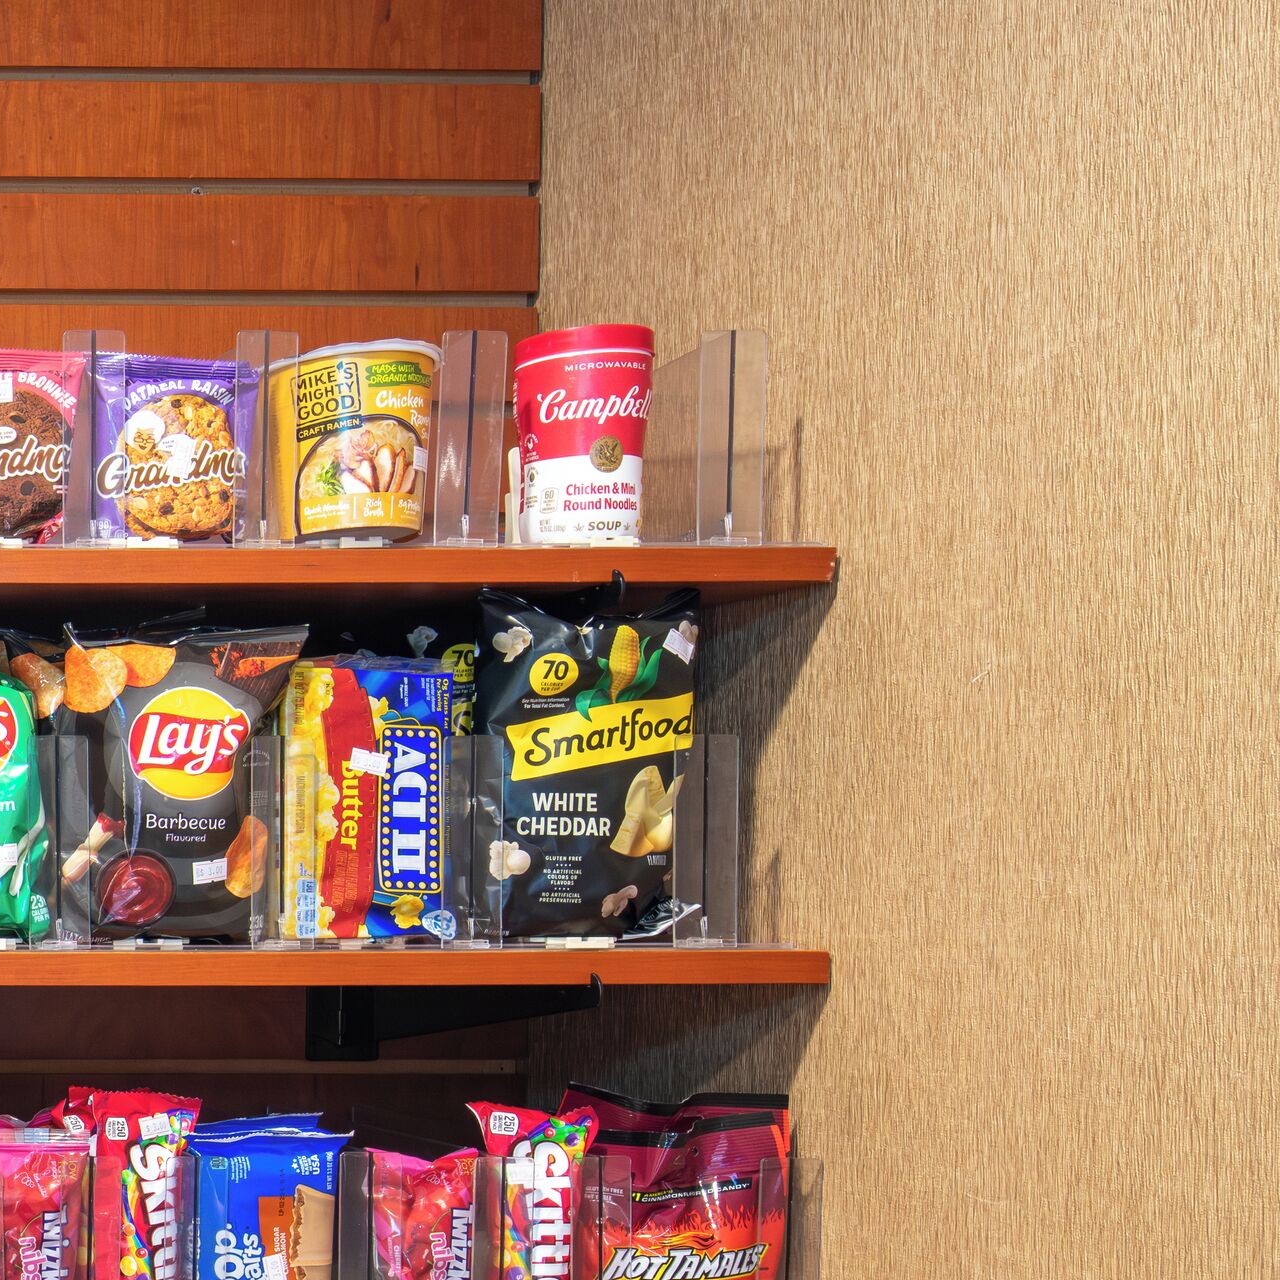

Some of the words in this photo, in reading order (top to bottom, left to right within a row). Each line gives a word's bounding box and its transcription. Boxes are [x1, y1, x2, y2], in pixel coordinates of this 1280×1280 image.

[565, 361, 646, 372] MICROWAVABLE
[18, 372, 77, 408] BROWNIE
[125, 380, 185, 409] OATMEAL
[192, 380, 234, 404] RAISIN
[297, 381, 354, 404] MIGHTY
[298, 395, 355, 420] GOOD
[298, 426, 325, 439] CRAFT
[327, 418, 360, 431] RAMEN
[564, 499, 600, 511] Round
[605, 499, 637, 511] Noodles
[588, 521, 622, 531] SOUP
[543, 660, 568, 680] 70
[138, 715, 244, 775] Lay's
[533, 793, 597, 812] WHITE
[146, 814, 226, 830] Barbecue
[517, 817, 610, 836] CHEDDAR
[117, 1121, 126, 1138] 250
